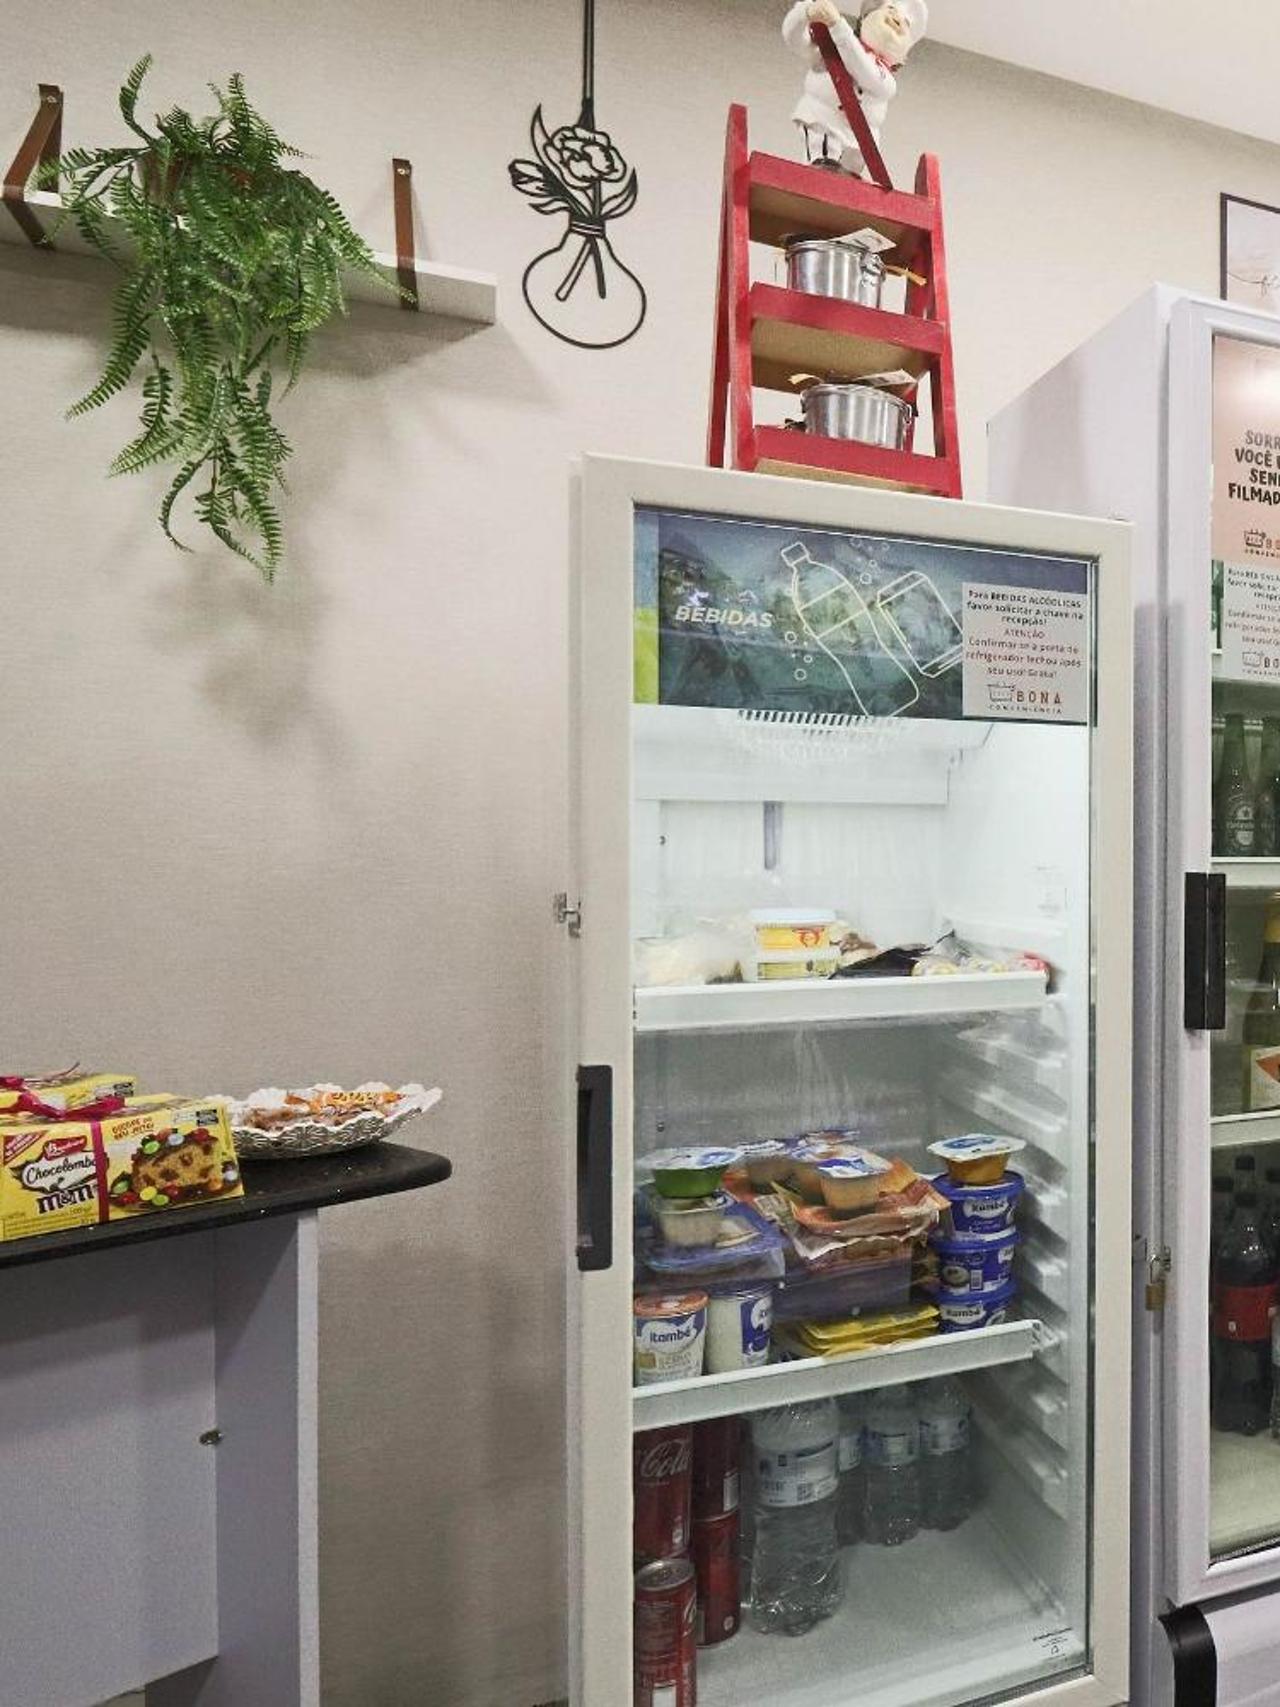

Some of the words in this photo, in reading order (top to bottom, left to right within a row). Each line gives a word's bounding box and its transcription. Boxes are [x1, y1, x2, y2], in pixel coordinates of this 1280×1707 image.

[1235, 447, 1272, 468] VOCÊ
[675, 605, 774, 627] BEBIDAS
[1017, 690, 1062, 704] BONA
